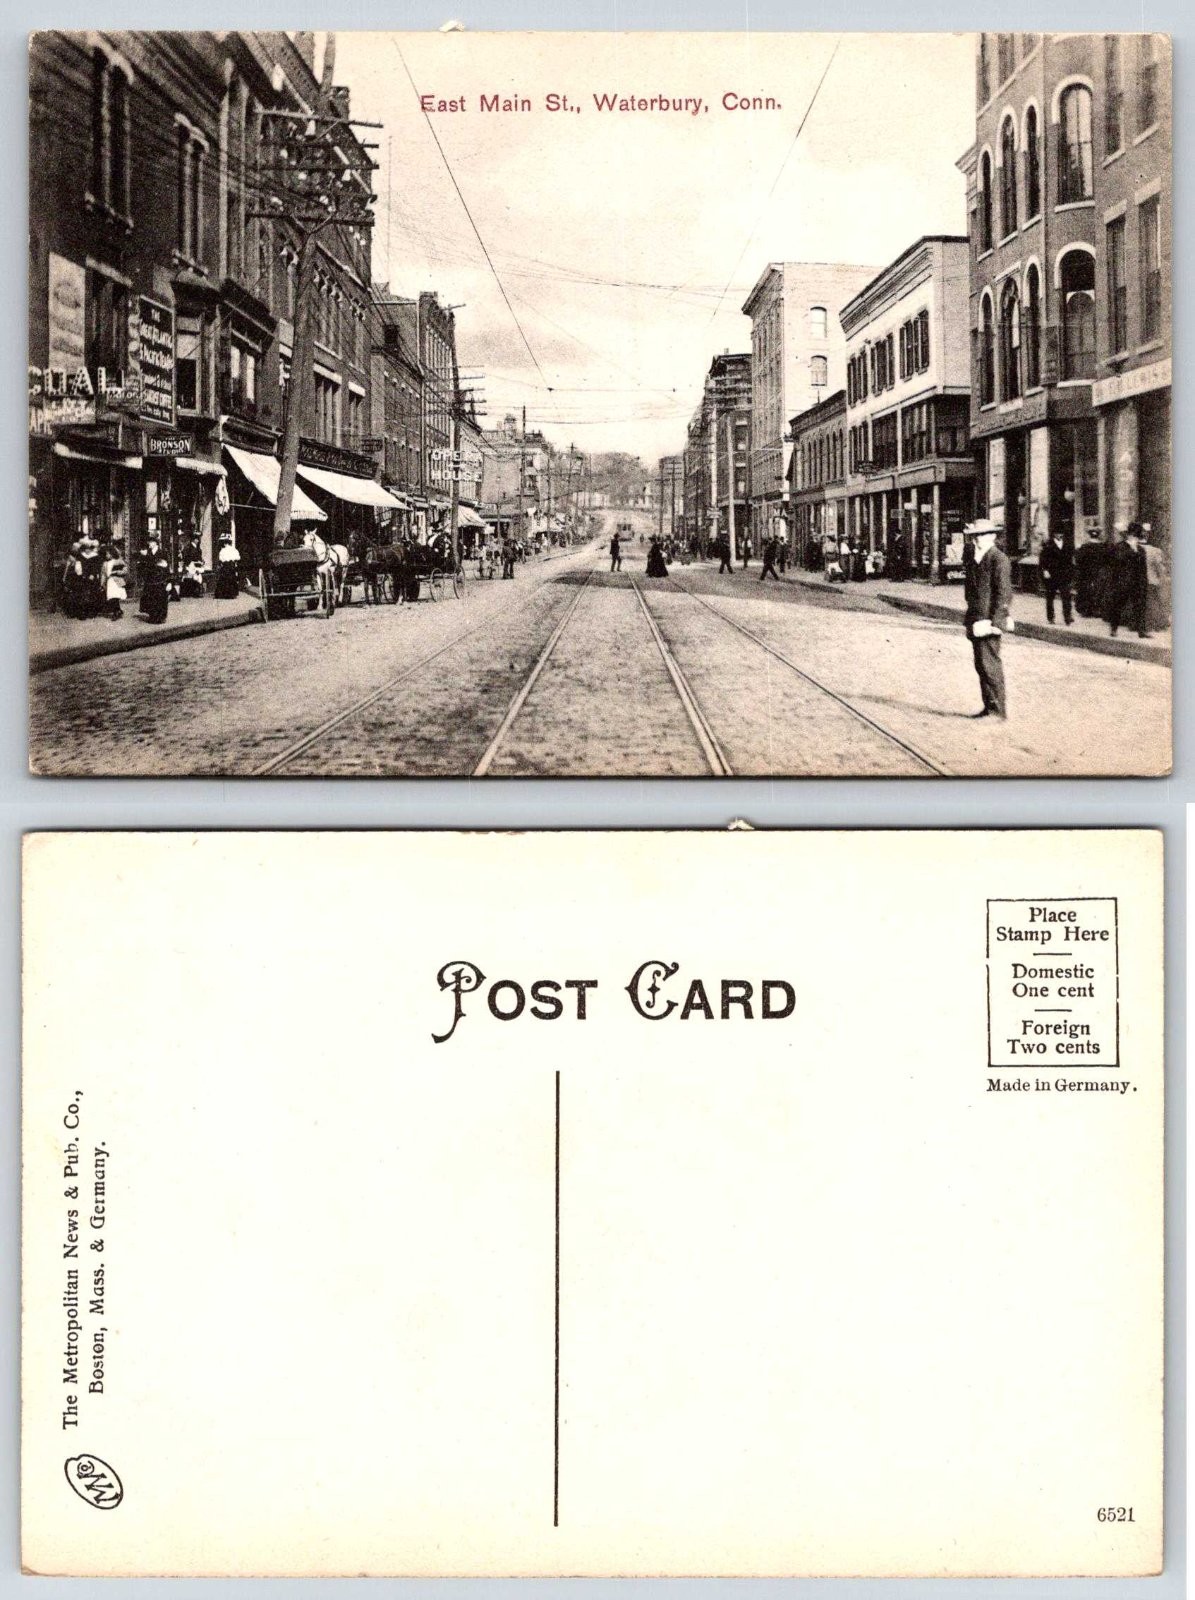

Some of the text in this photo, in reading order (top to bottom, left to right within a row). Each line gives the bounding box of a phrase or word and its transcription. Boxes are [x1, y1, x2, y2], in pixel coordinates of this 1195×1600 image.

[150, 438, 191, 451] BRONSON
[1029, 906, 1077, 923] Place
[996, 925, 1110, 945] Stamp Here
[1011, 963, 1095, 979] Domestic
[1012, 982, 1095, 998] One cent
[431, 960, 796, 1044] POST CARD
[1021, 1019, 1091, 1039] Foreign
[1006, 1038, 1101, 1055] Two cents
[986, 1078, 1138, 1095] Made in Germany.
[61, 1090, 84, 1430] The Metropolitan News & Pub. Co.,
[88, 1141, 110, 1394] Boston, Mass. & Germany.
[1097, 1507, 1136, 1522] 6521
